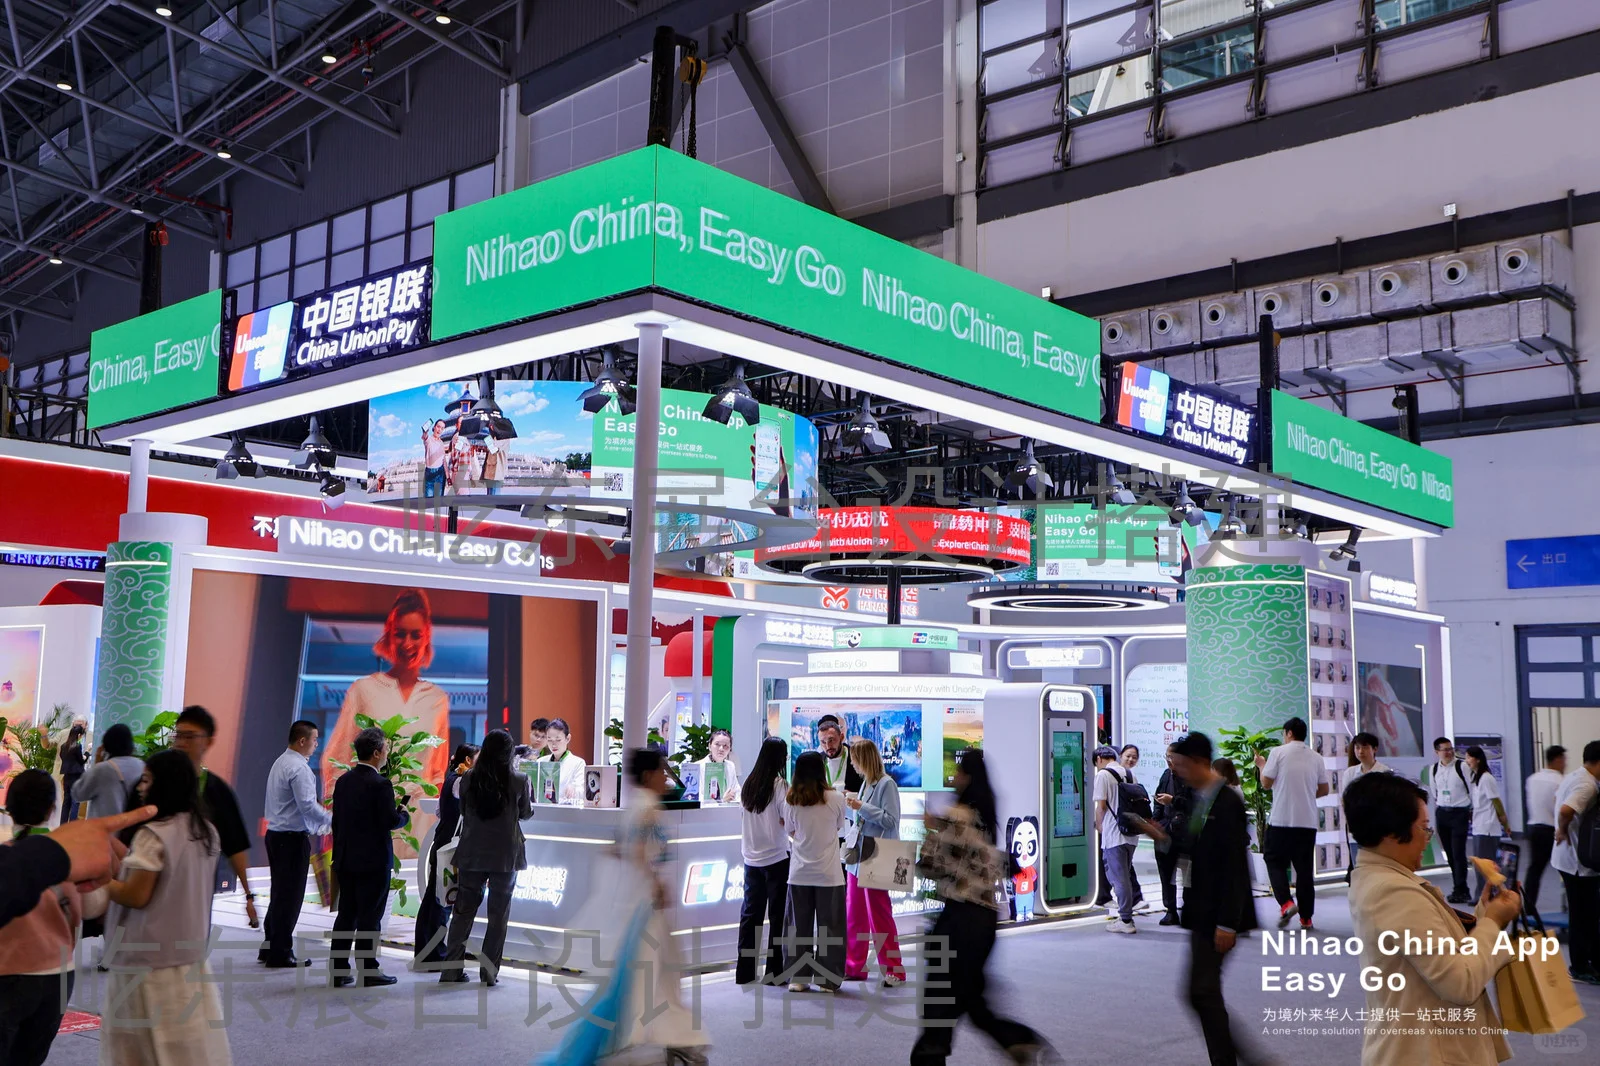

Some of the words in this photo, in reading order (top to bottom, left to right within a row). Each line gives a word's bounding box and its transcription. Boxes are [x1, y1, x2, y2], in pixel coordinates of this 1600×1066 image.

[302, 265, 427, 338] 中国银联
[465, 227, 563, 286] Nihao
[700, 206, 790, 285] Easy
[795, 245, 846, 297] Go
[862, 267, 945, 331] Nihao
[1033, 331, 1090, 387] Easy
[154, 337, 207, 375] Easy
[297, 340, 337, 365] China
[341, 319, 417, 355] UnionPay
[604, 417, 635, 433] Eas
[1176, 391, 1250, 442] 中国银联
[1173, 421, 1202, 446] China
[1203, 432, 1247, 465] UnionPay
[1287, 421, 1328, 460] Nihao
[1329, 437, 1369, 479] China,
[1370, 452, 1399, 489] Easy
[1400, 463, 1417, 490] Go
[1421, 471, 1451, 502] Nihao
[290, 519, 364, 550] Nihao
[503, 542, 536, 567] Go
[1045, 514, 1081, 524] Nihao
[1085, 514, 1120, 525] China
[1124, 516, 1148, 527] App
[1045, 526, 1075, 537] Easy
[1079, 526, 1096, 536] Go
[1542, 553, 1567, 564] 出口
